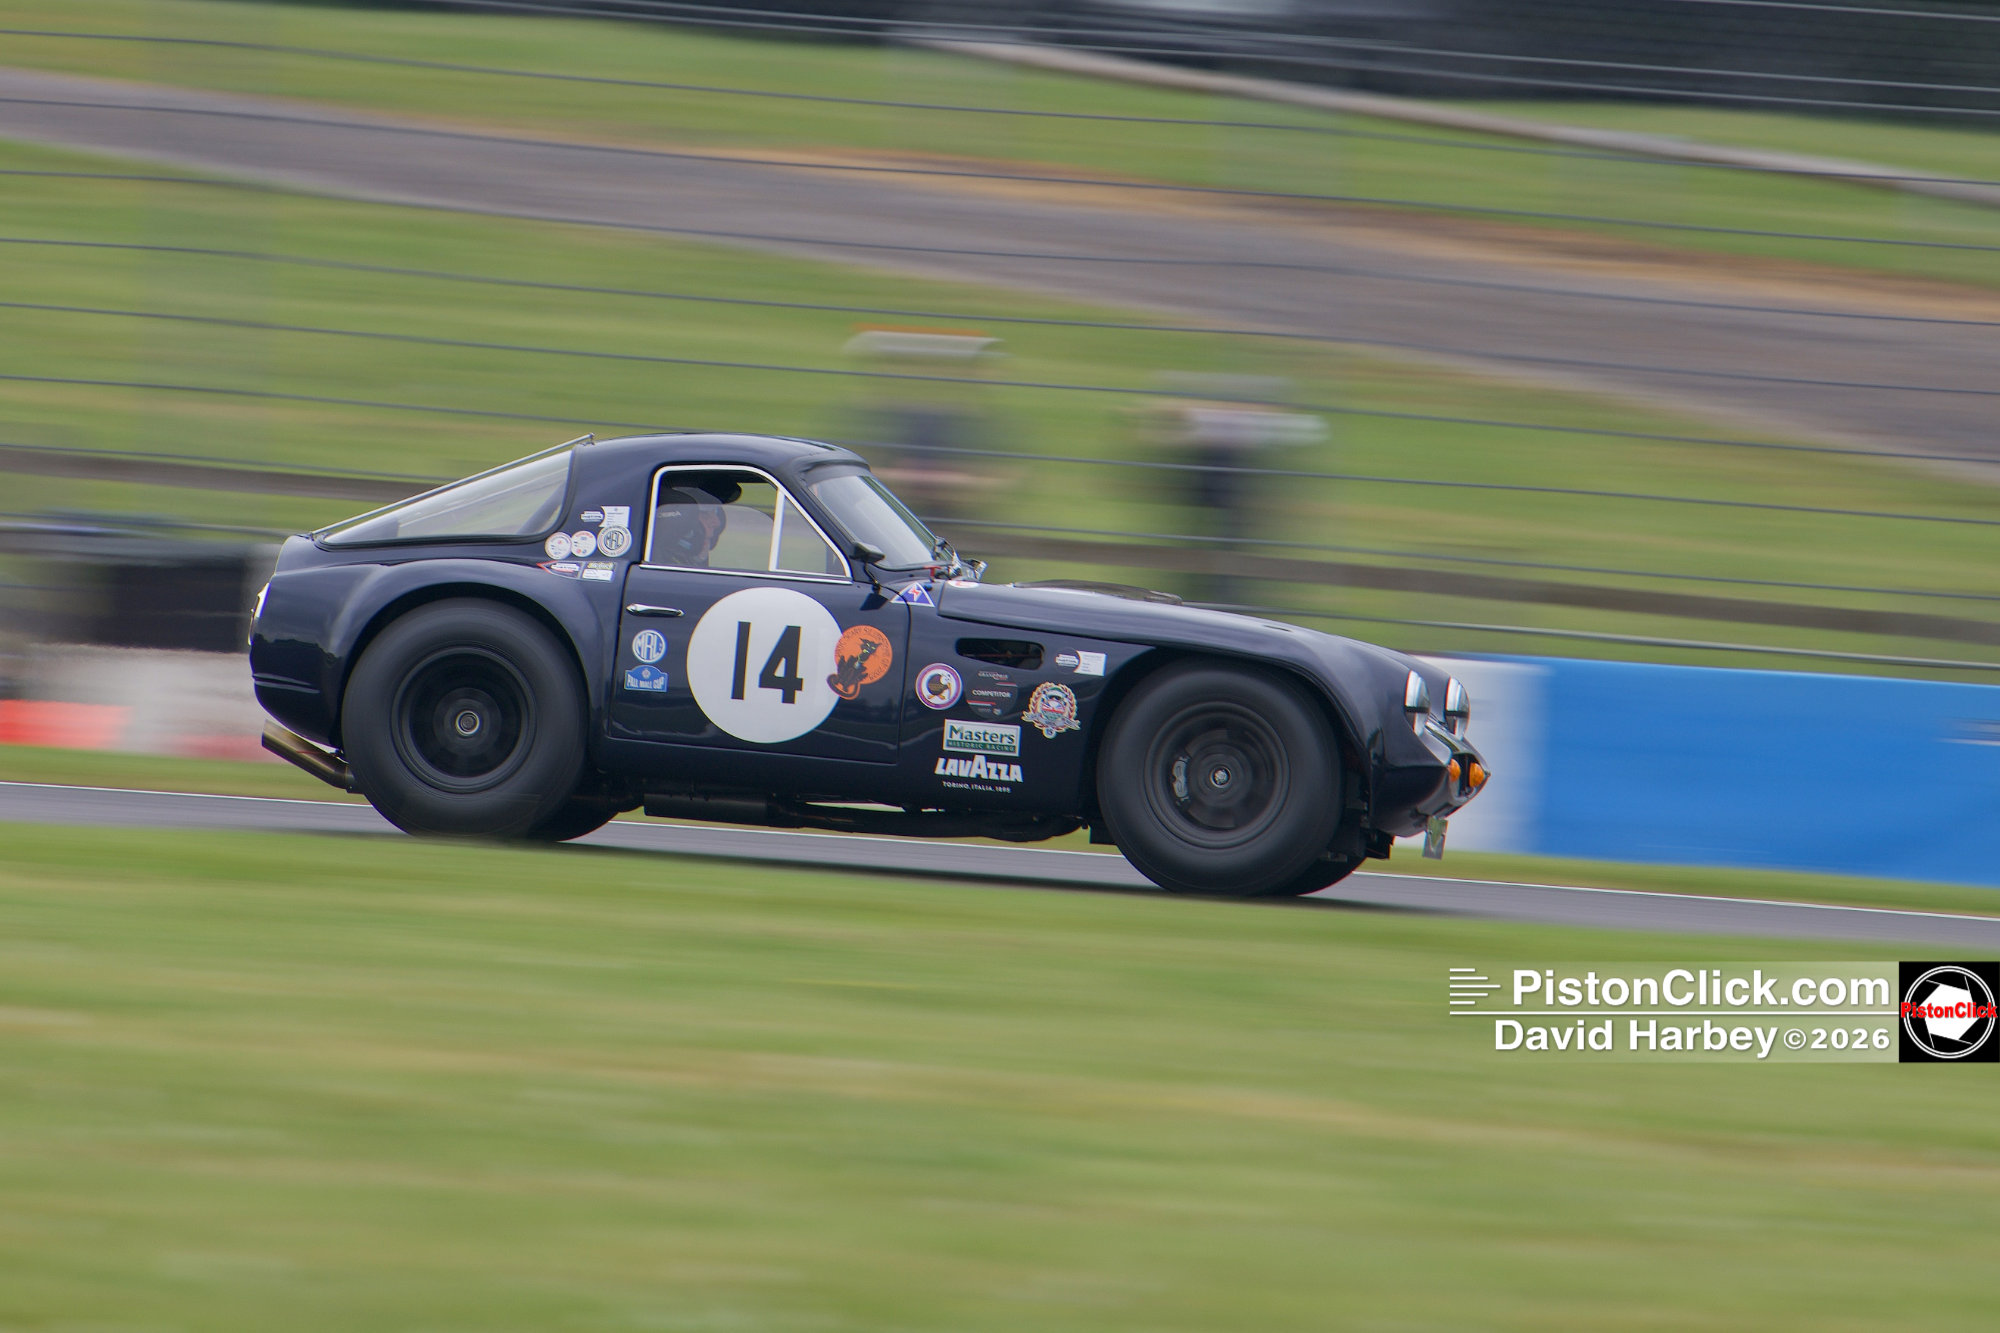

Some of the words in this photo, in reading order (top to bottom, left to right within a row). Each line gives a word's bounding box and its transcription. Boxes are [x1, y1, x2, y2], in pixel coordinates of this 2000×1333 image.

[730, 620, 805, 705] 14
[627, 673, 639, 688] PALL
[639, 680, 652, 689] MALL
[653, 676, 665, 690] CUP
[972, 689, 1012, 699] COMPETITOR
[949, 724, 1016, 745] Masters
[947, 740, 983, 750] HISTORIC
[986, 743, 1015, 753] RACING
[934, 754, 1023, 783] LAVAZZA
